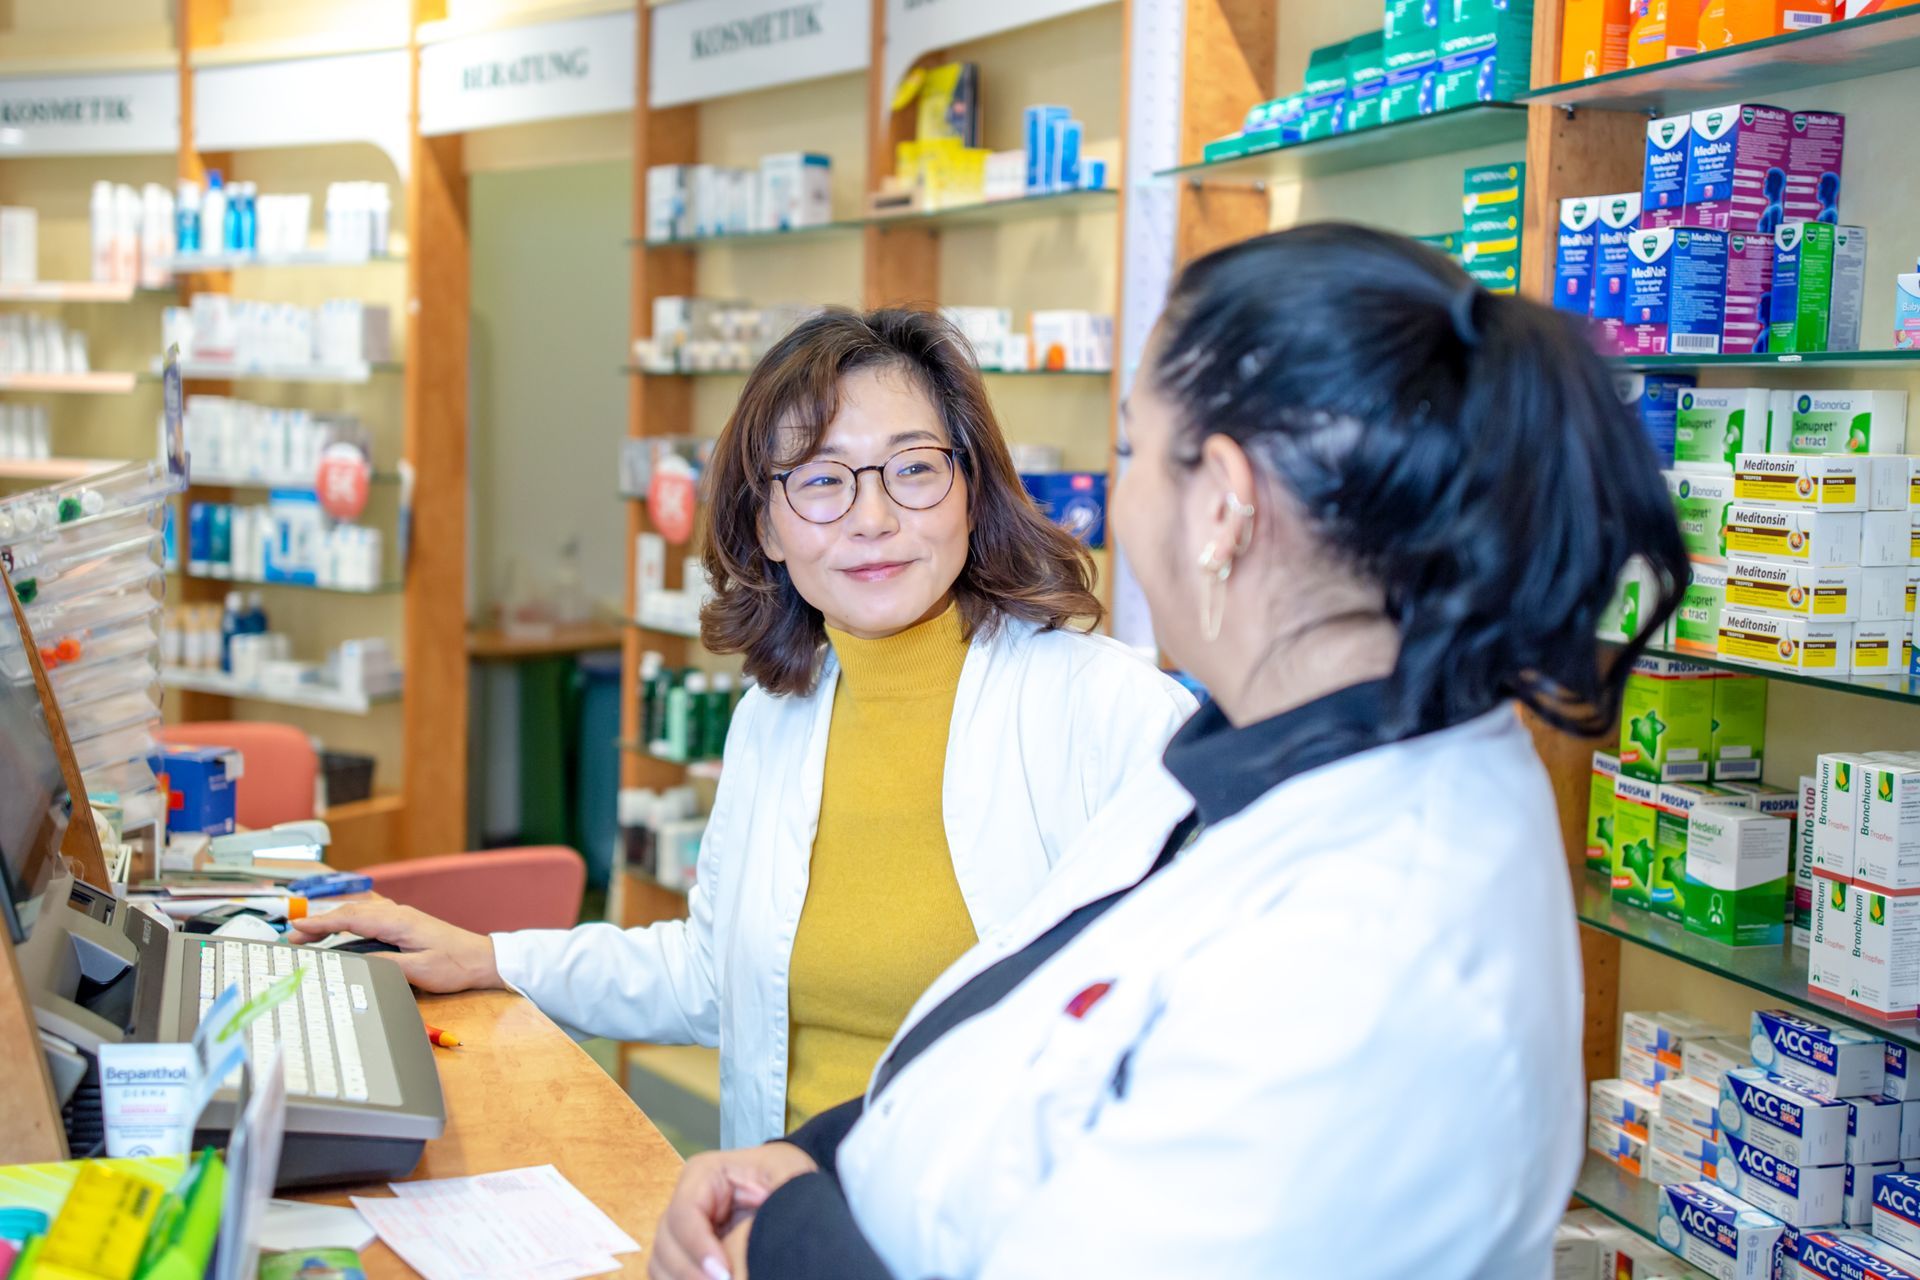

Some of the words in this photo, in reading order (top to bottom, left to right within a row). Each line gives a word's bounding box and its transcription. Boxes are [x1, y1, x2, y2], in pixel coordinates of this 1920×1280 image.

[690, 3, 823, 60] KOSMETIK
[462, 48, 590, 90] BERATUNG
[0, 97, 133, 123] KOSMETIK
[1814, 400, 1851, 410] Bionorica
[1795, 420, 1833, 433] Sinupret
[1795, 436, 1826, 446] extract
[1743, 459, 1795, 473] Meditonsin
[1692, 486, 1722, 498] Bionorica
[1735, 511, 1786, 526] Meditonsin
[1735, 565, 1787, 580] Meditonsin
[1727, 616, 1777, 633] Meditonsin
[1618, 782, 1651, 799] PROSPAN
[1818, 763, 1830, 826] Bronchicum
[1860, 772, 1872, 836] Bronchicum
[1691, 819, 1722, 837] Hedelix
[1828, 819, 1850, 832] Tropfen
[1870, 829, 1894, 843] Tropfen
[1814, 881, 1825, 944] Bronchicum
[1852, 894, 1864, 958] Bronchicum
[1862, 951, 1886, 965] Tropfen
[1773, 1026, 1812, 1056] ACC
[1812, 1041, 1834, 1056] akut
[1887, 1045, 1903, 1059] kut
[106, 1066, 187, 1084] Bepanthol
[122, 1089, 167, 1098] DERMA
[1741, 1086, 1780, 1117] ACC
[1780, 1103, 1801, 1117] akut
[1738, 1144, 1776, 1177] ACC
[1776, 1163, 1797, 1178] akut
[1878, 1184, 1917, 1216] ACC
[1680, 1204, 1716, 1238] ACC
[1717, 1224, 1738, 1240] akut
[1785, 1226, 1799, 1241] kut
[1803, 1244, 1840, 1277] ACC
[1841, 1263, 1864, 1280] akut
